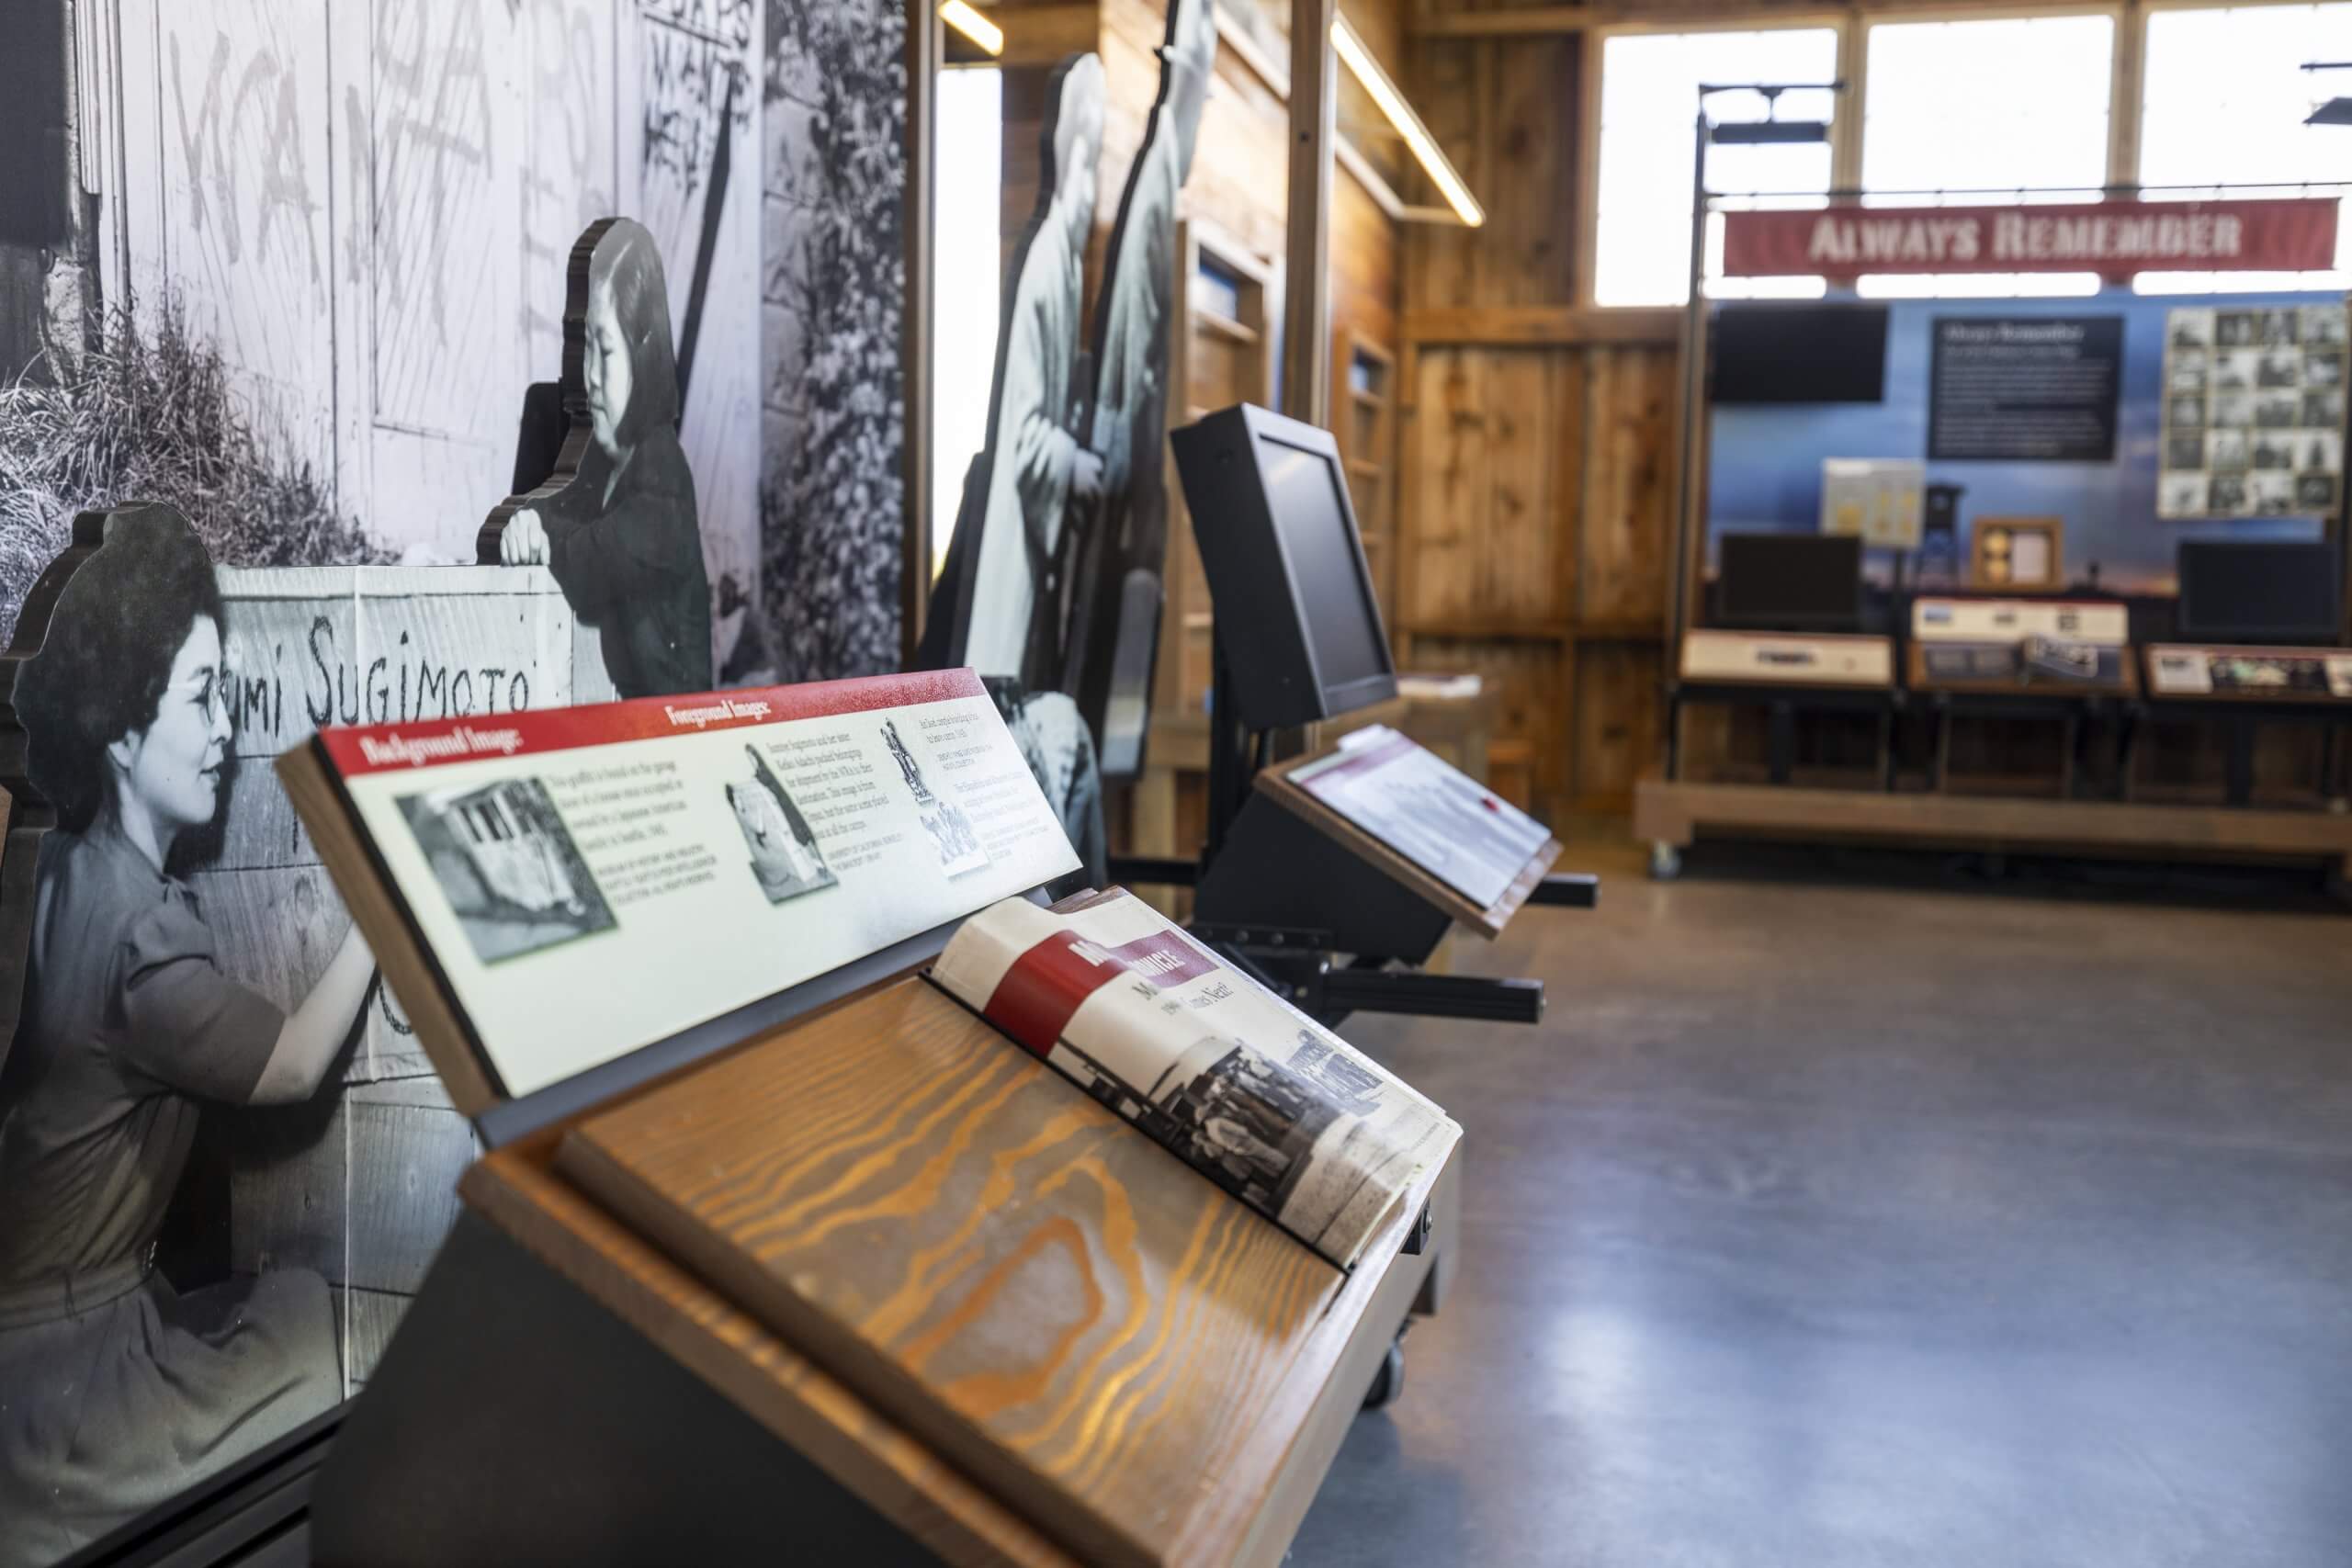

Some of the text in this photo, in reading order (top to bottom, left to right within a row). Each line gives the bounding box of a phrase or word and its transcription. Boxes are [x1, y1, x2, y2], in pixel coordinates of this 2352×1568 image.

[1809, 211, 2242, 262] ALWAYS REMEMBER
[663, 699, 734, 728] Foreground
[359, 726, 468, 766] Background
